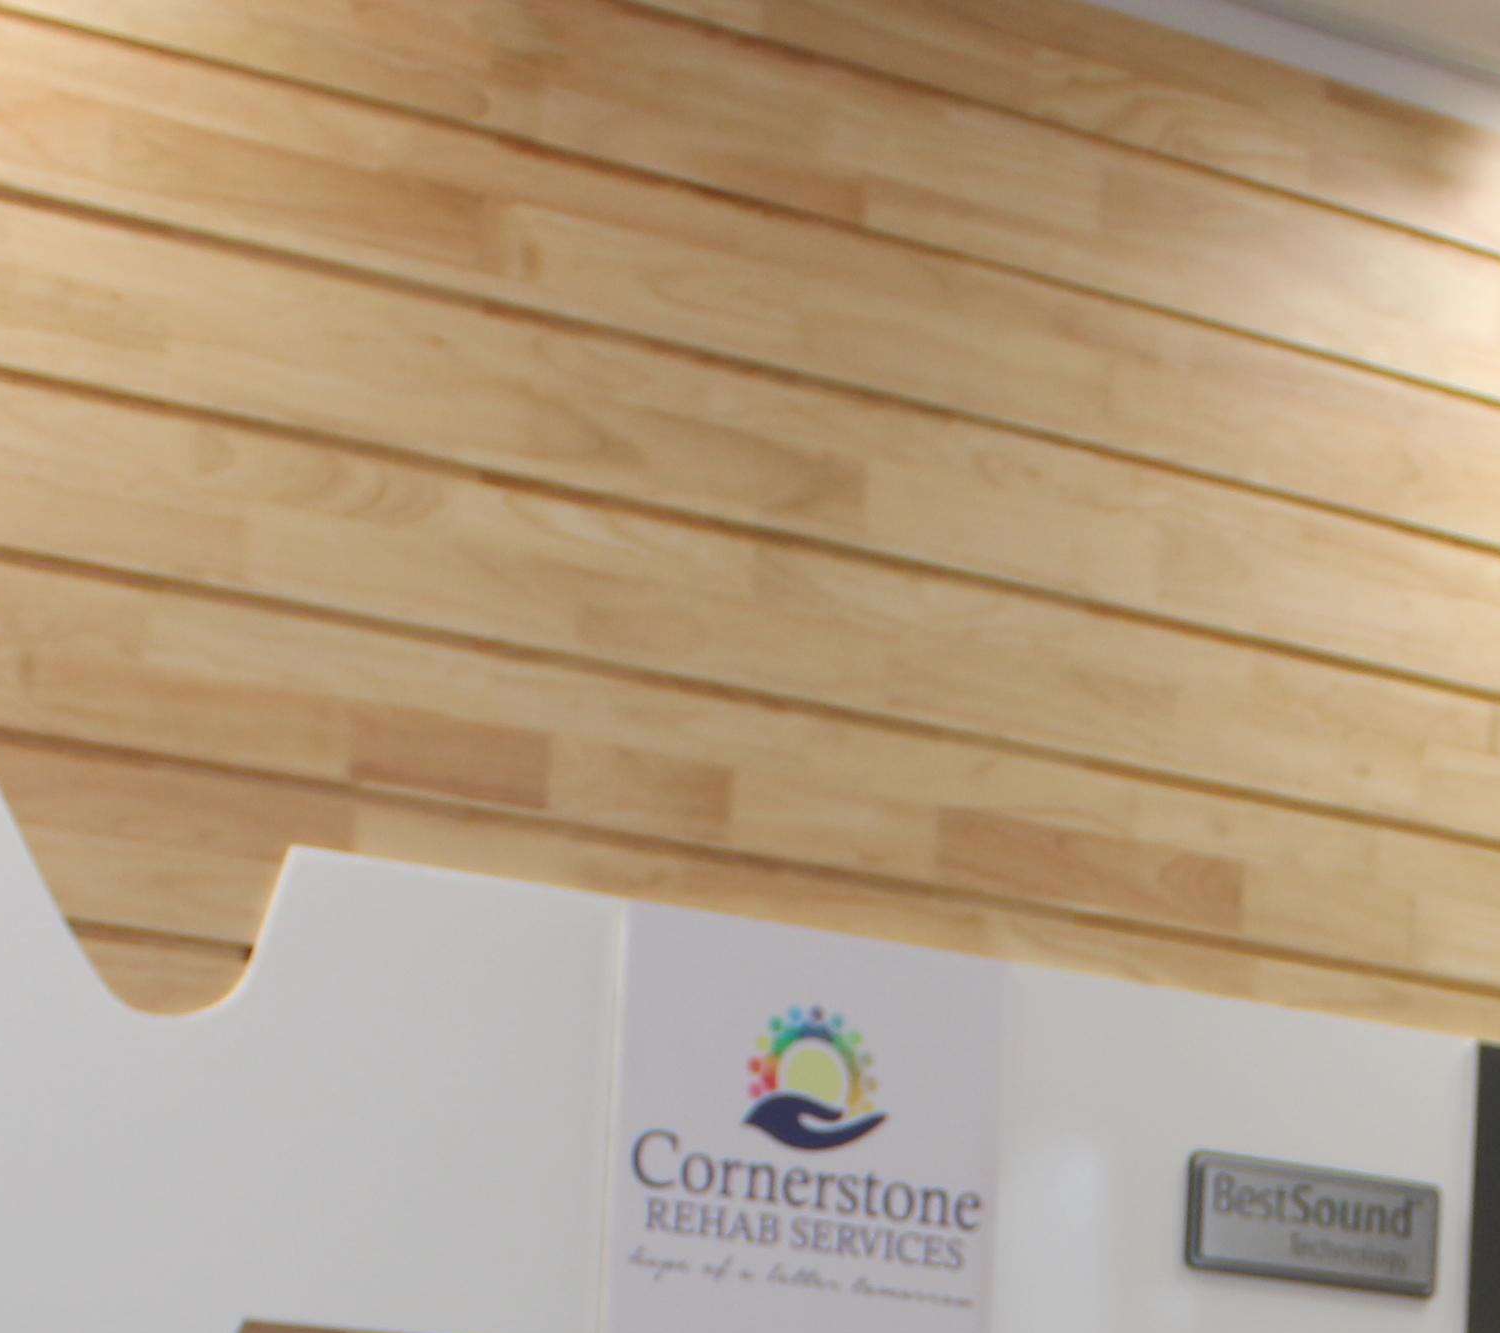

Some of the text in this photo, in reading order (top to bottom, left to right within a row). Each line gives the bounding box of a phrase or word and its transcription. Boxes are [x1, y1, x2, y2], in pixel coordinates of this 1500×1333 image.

[630, 1129, 983, 1232] Cornerstone
[1212, 1170, 1414, 1240] BestSound
[645, 1197, 965, 1271] REHAB SERVICES
